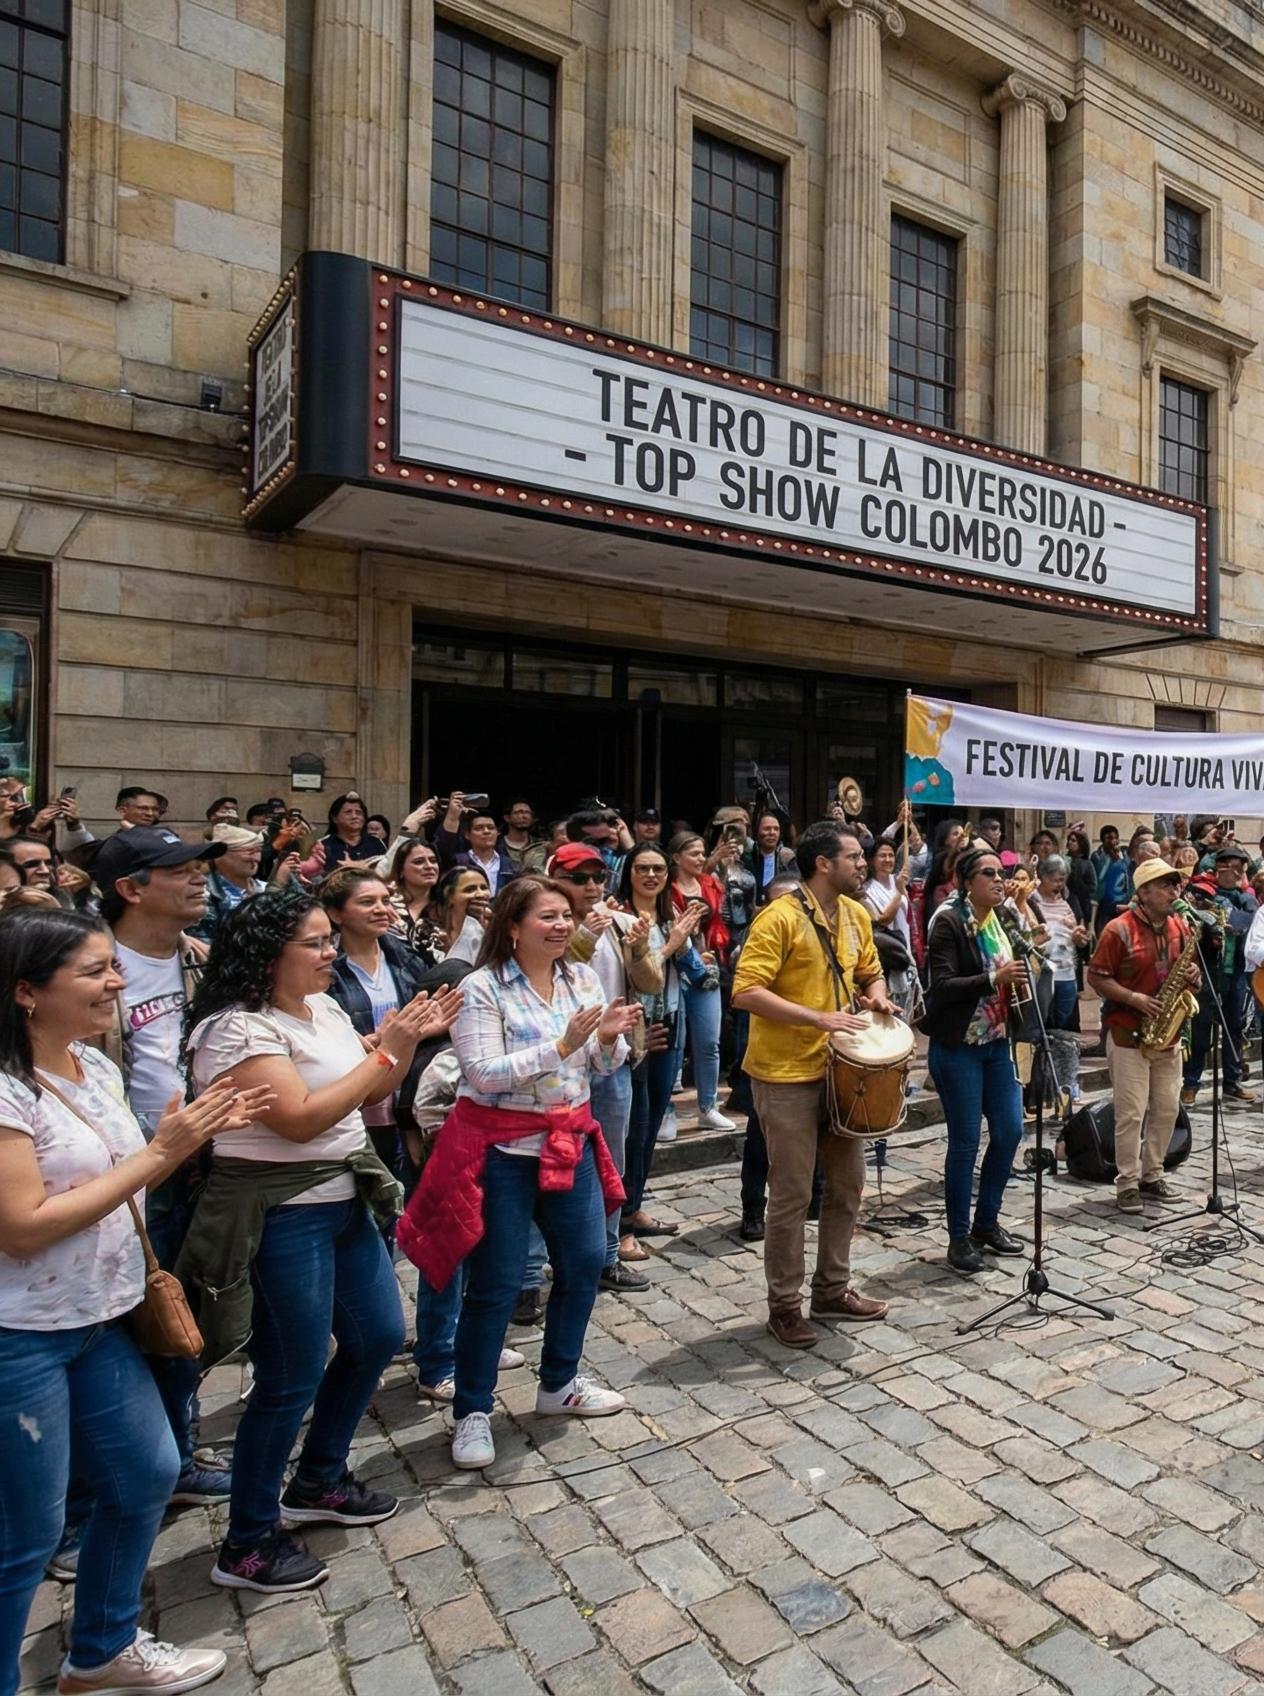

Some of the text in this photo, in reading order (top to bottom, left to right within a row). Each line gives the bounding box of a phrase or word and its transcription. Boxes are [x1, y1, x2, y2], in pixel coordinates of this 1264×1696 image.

[593, 369, 764, 457] TEATRO
[790, 421, 837, 476] DE
[859, 439, 902, 492] LA
[606, 433, 695, 496] TOP
[720, 462, 840, 529] SHOW
[861, 495, 1021, 567] COLOMBO
[1039, 535, 1106, 584] 2026
[967, 739, 1084, 782] FESTIVAL
[1094, 752, 1124, 785] DE
[1131, 755, 1224, 789] CULTURA
